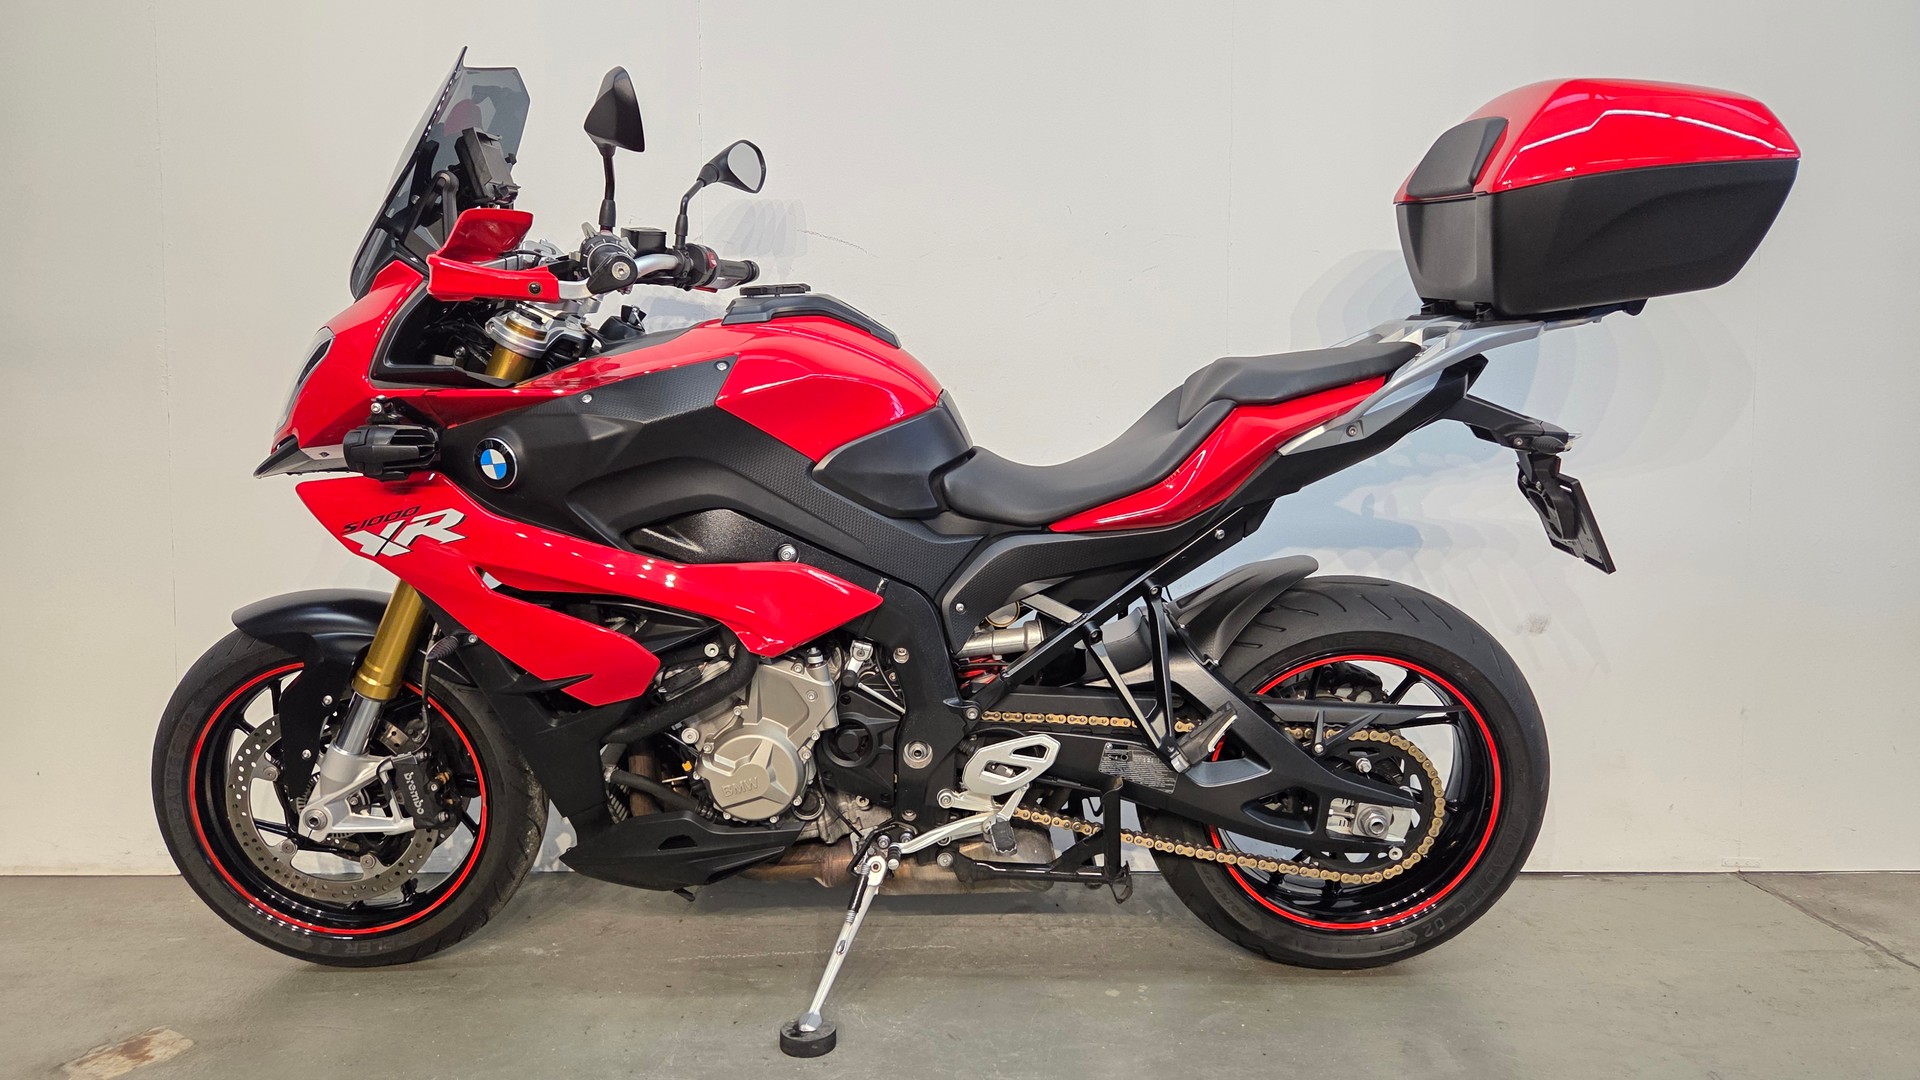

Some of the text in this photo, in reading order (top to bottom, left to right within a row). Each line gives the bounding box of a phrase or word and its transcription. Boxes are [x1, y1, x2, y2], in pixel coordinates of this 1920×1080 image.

[342, 508, 468, 557] XR
[343, 506, 421, 534] S1000
[403, 771, 425, 815] brembo
[721, 776, 760, 798] BMW
